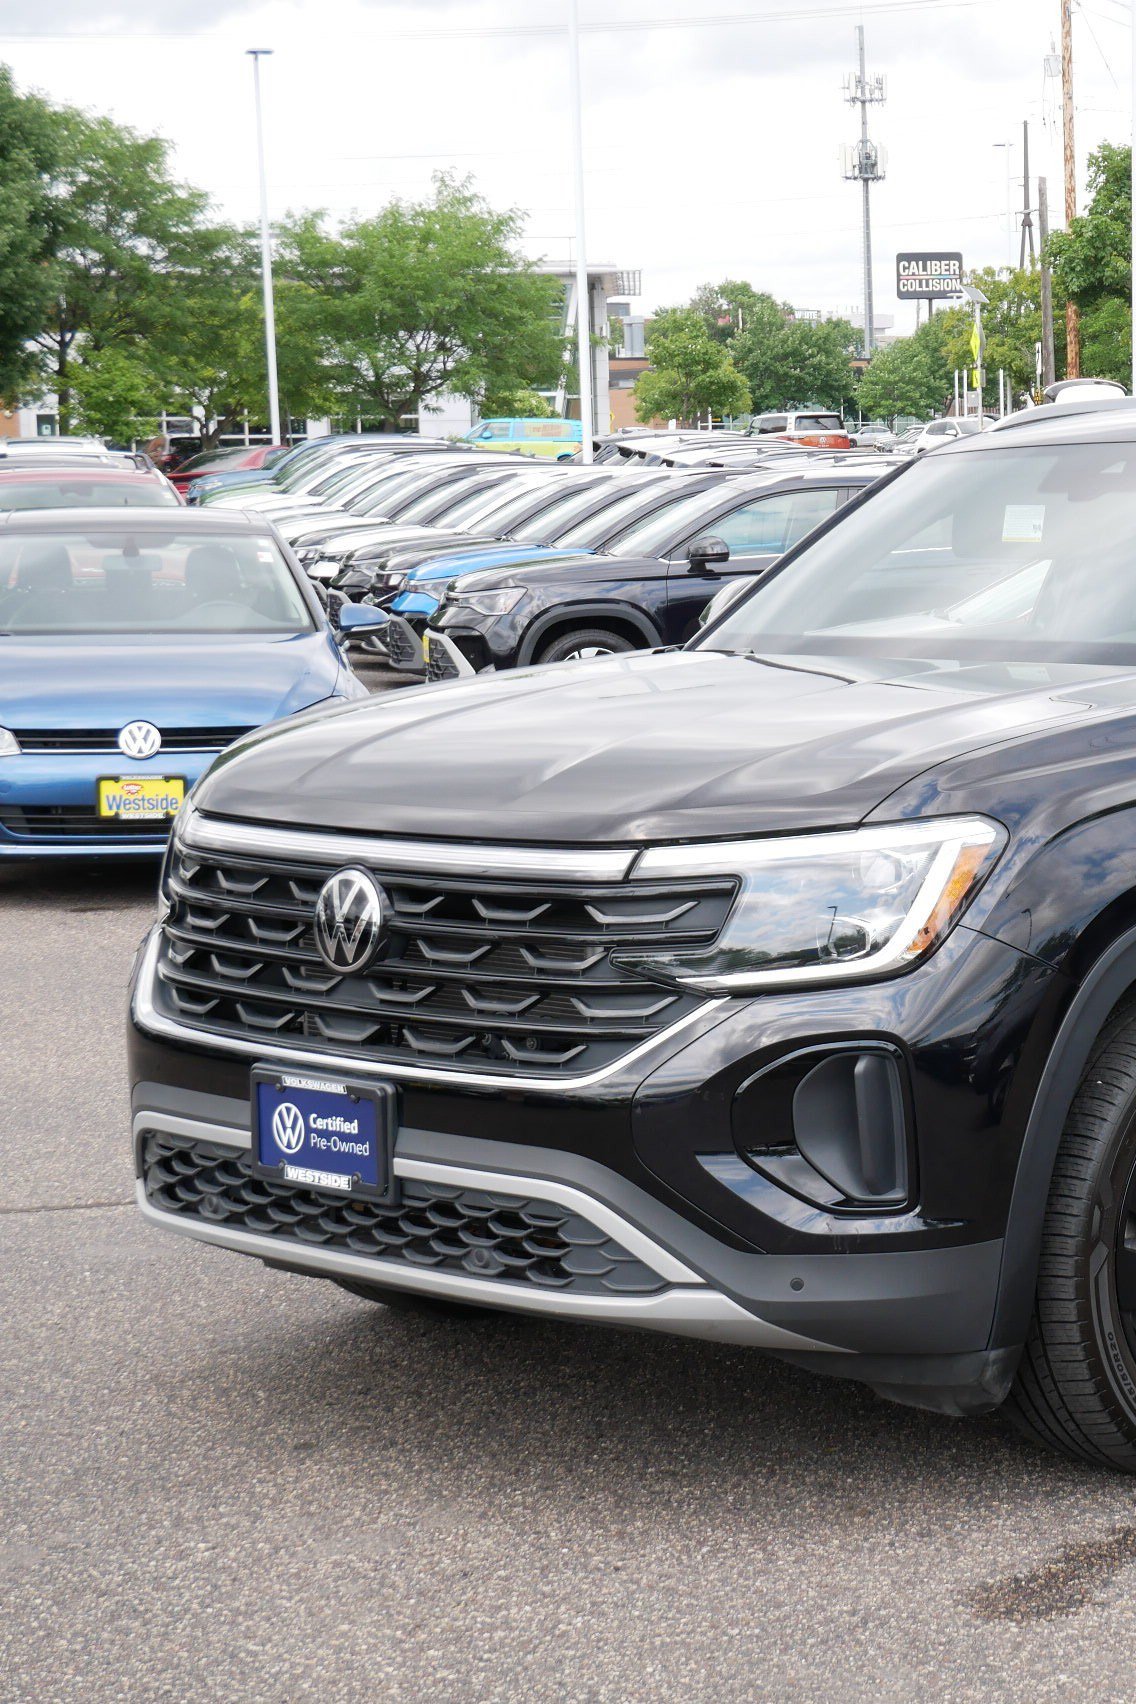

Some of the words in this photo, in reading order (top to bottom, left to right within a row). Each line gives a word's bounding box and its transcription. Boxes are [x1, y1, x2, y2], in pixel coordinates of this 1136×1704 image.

[899, 260, 960, 275] CALIBER
[900, 279, 960, 291] COLLISION
[105, 793, 179, 811] Westside
[317, 869, 380, 972] VW
[284, 1077, 346, 1094] VOLKSWAGEN
[273, 1102, 304, 1154] VW
[309, 1113, 358, 1134] Certified
[310, 1133, 370, 1156] Pre-Owned
[286, 1166, 350, 1189] WESTSIDE
